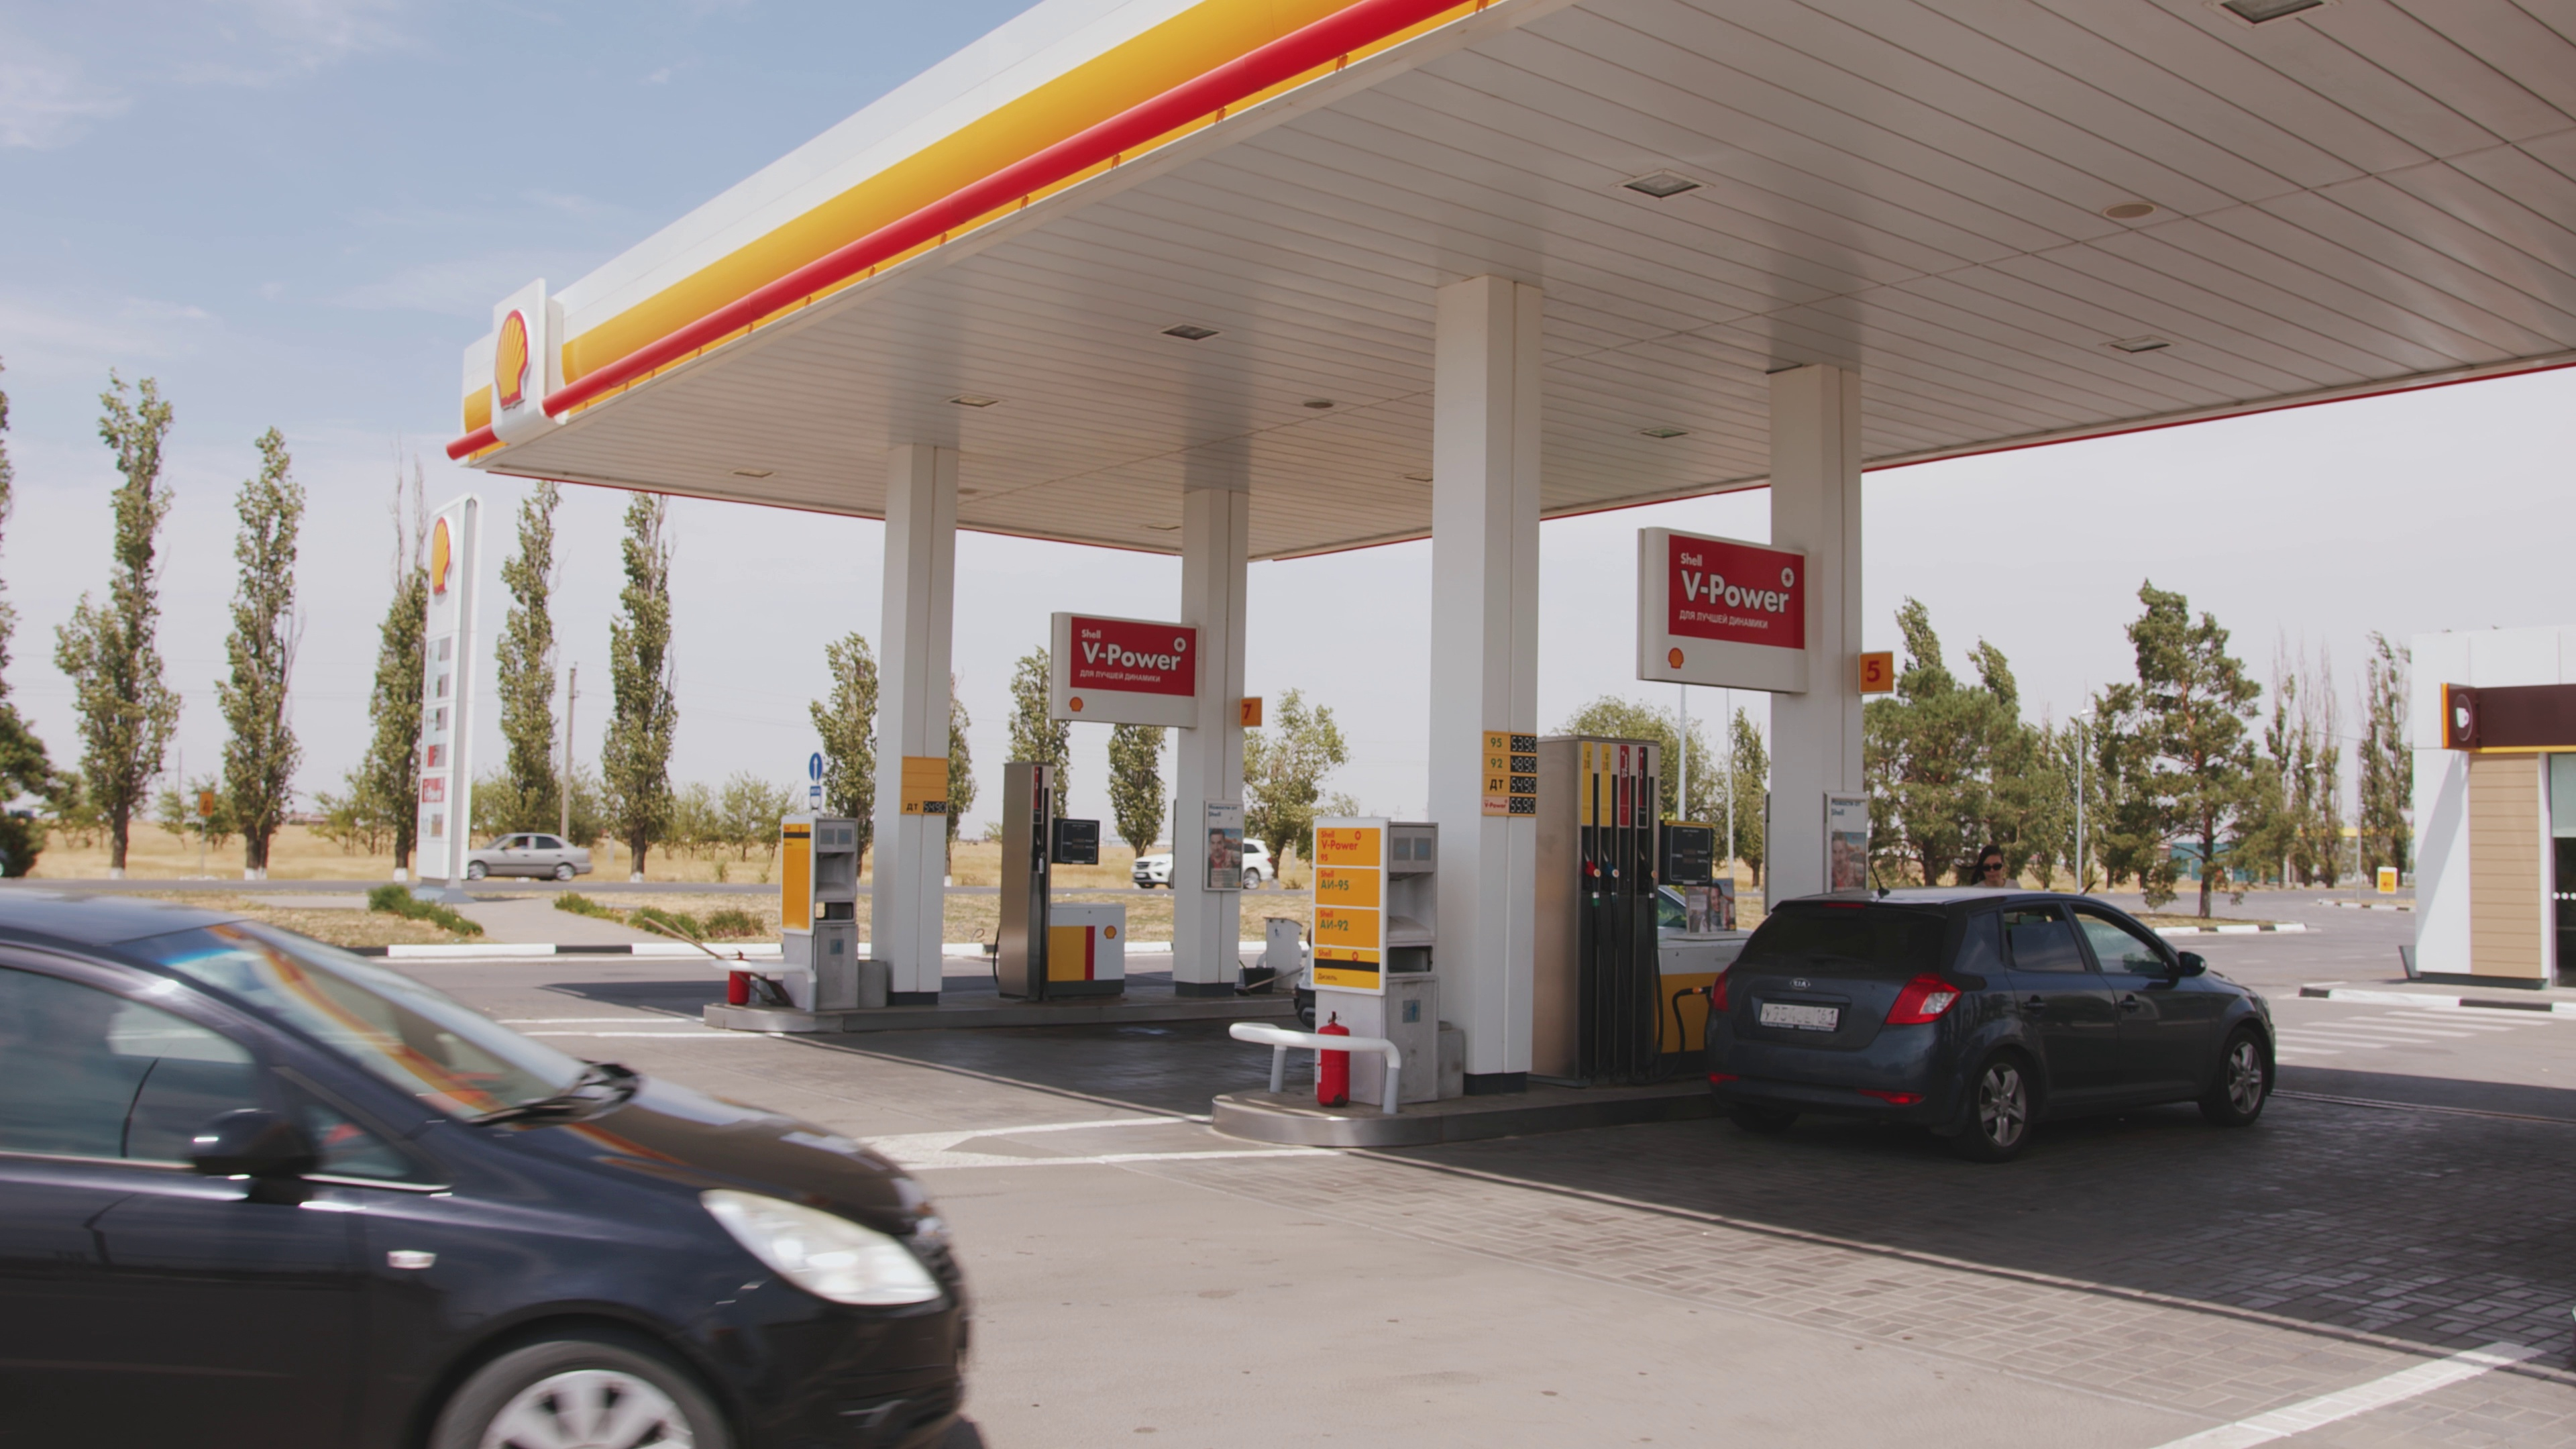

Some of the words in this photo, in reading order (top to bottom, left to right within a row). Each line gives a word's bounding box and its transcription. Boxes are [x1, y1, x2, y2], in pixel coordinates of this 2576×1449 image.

[1680, 553, 1703, 566] Shell
[1681, 570, 1789, 613] V-Power
[1679, 610, 1695, 621] ДЛЯ
[1697, 612, 1728, 624] ЛУЧШЕЙ
[1729, 616, 1768, 629] ДИНАМИКИ
[1081, 629, 1101, 639] Shell
[1081, 641, 1181, 671] V-Power
[1080, 669, 1094, 678] ДЛЯ
[1095, 671, 1124, 680] ЛУЧШЕЙ
[1124, 674, 1161, 682] ДИНАМИКИ
[1867, 661, 1880, 682] 5
[1243, 703, 1252, 719] 7
[1491, 737, 1502, 747] 95
[1491, 758, 1503, 768] 92
[1490, 779, 1503, 791] ДТ
[1321, 830, 1335, 839] Shell
[1322, 840, 1358, 851] V-Power
[1320, 853, 1328, 861] 95
[1321, 870, 1334, 878] Shell
[1321, 879, 1349, 891] АИ-95
[1320, 910, 1334, 918] Shell
[1320, 919, 1348, 931] АИ-92
[1318, 949, 1332, 957] Shell
[1318, 973, 1338, 981] Дизель
